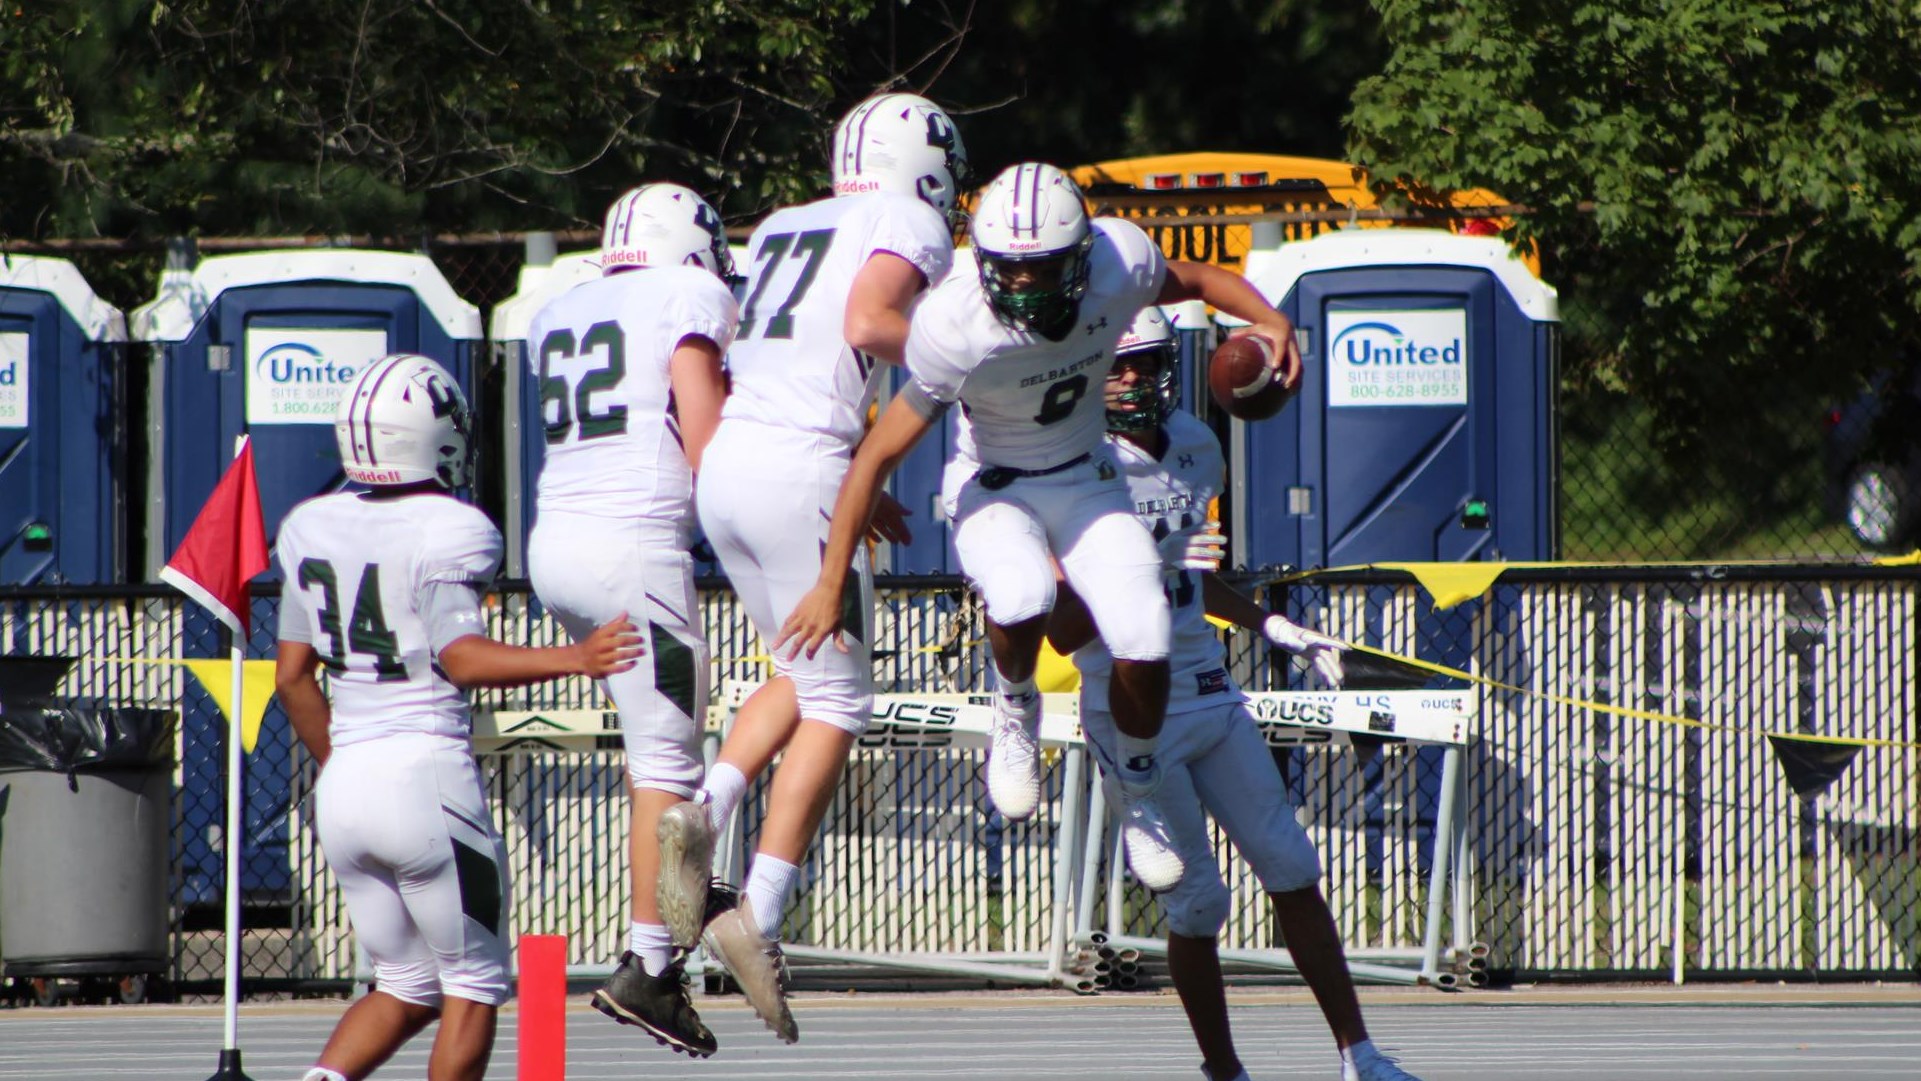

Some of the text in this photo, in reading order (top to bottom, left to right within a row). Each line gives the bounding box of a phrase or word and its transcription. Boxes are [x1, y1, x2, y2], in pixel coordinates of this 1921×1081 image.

[602, 250, 648, 266] Riddell
[1009, 242, 1042, 251] Riddell
[735, 228, 837, 341] 77
[1347, 338, 1460, 366] United
[271, 358, 374, 383] Unite
[1020, 350, 1103, 389] DELBARTON
[1348, 368, 1461, 384] SITE SERVICES
[271, 387, 302, 400] SITE
[540, 319, 628, 445] 62
[1350, 383, 1460, 398] 800-628-8955
[298, 557, 411, 682] 34
[1279, 700, 1334, 724] UCS
